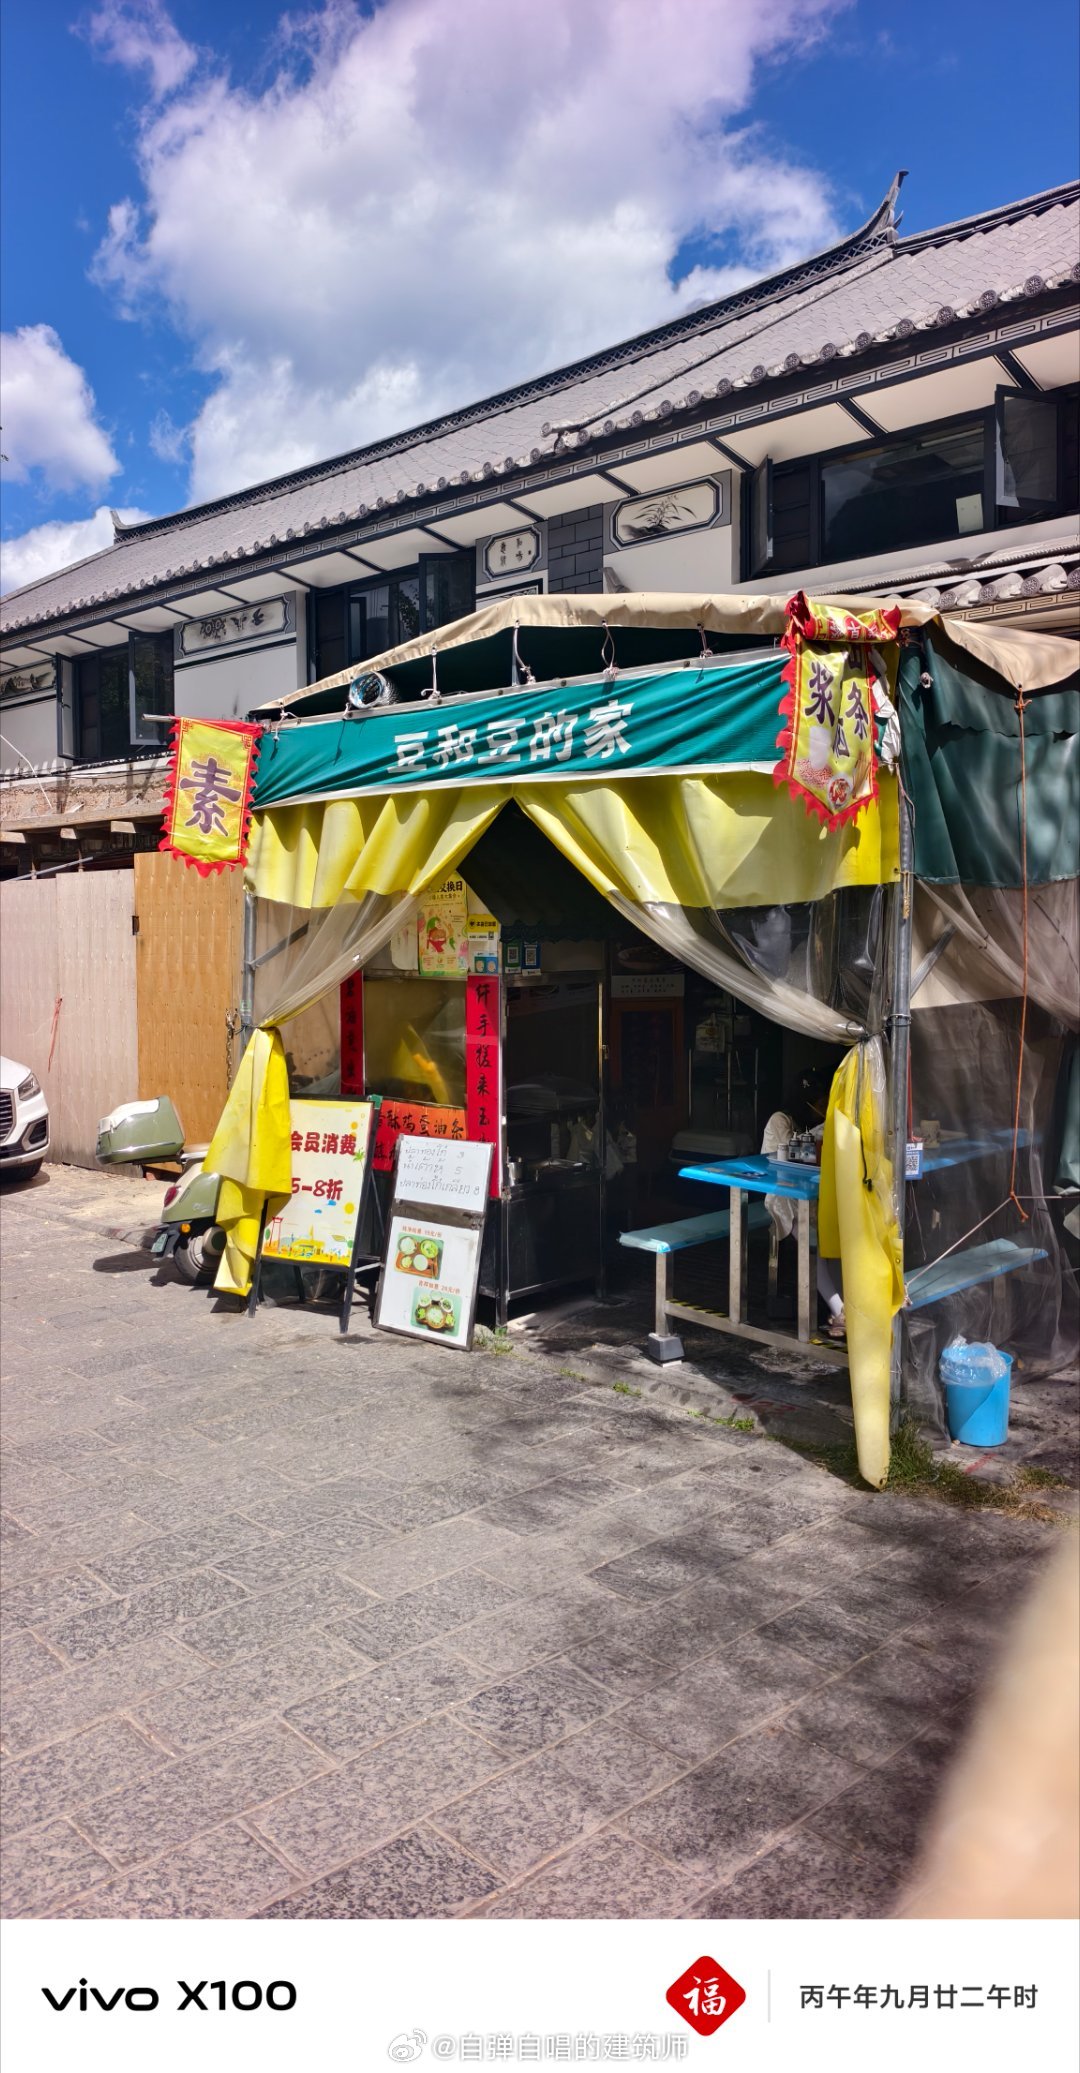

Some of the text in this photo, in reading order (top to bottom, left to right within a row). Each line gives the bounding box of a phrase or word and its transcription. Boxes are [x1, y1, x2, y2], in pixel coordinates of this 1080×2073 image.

[805, 645, 835, 727] 浆
[388, 699, 634, 773] 豆和豆的家
[179, 757, 242, 837] 素
[290, 1130, 357, 1156] 会员消费
[454, 1166, 464, 1175] 5
